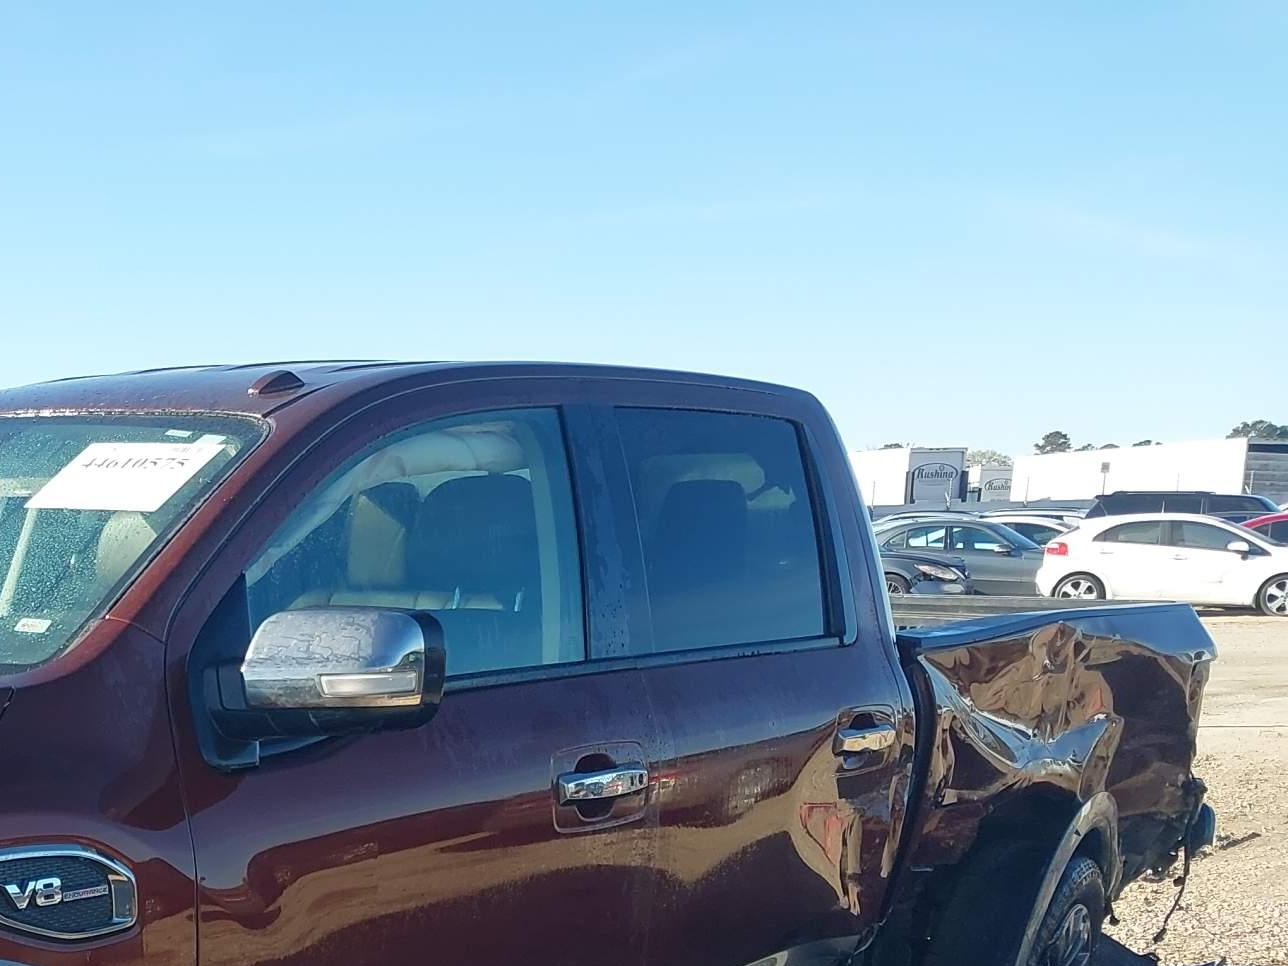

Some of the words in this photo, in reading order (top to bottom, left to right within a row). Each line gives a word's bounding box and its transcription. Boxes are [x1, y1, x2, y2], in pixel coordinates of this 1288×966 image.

[82, 457, 191, 470] 44610575
[917, 467, 954, 481] Rushing
[4, 877, 63, 910] V8
